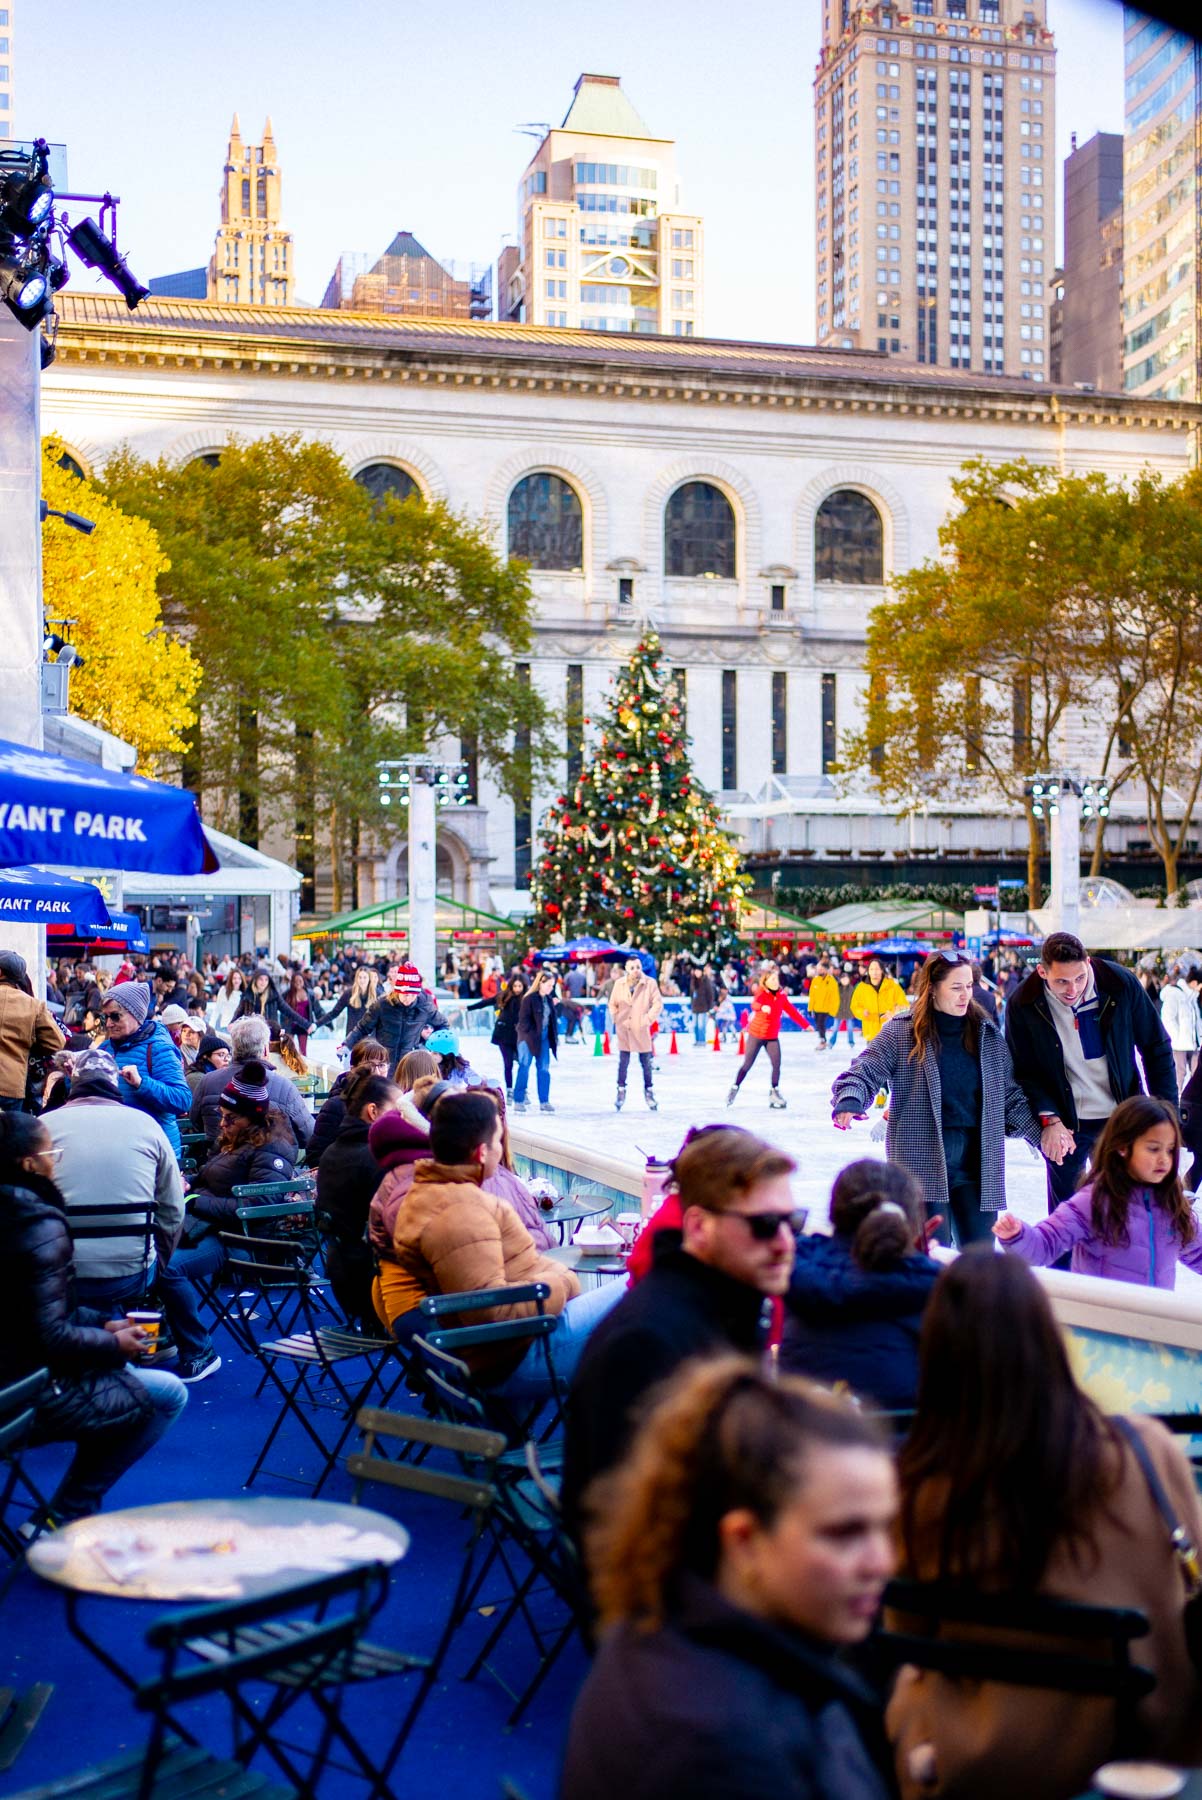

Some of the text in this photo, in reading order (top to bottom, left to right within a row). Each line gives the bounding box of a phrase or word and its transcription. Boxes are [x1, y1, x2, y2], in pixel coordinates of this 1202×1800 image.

[74, 811, 148, 842] PARK
[35, 900, 72, 913] PARK
[113, 922, 128, 932] PARK
